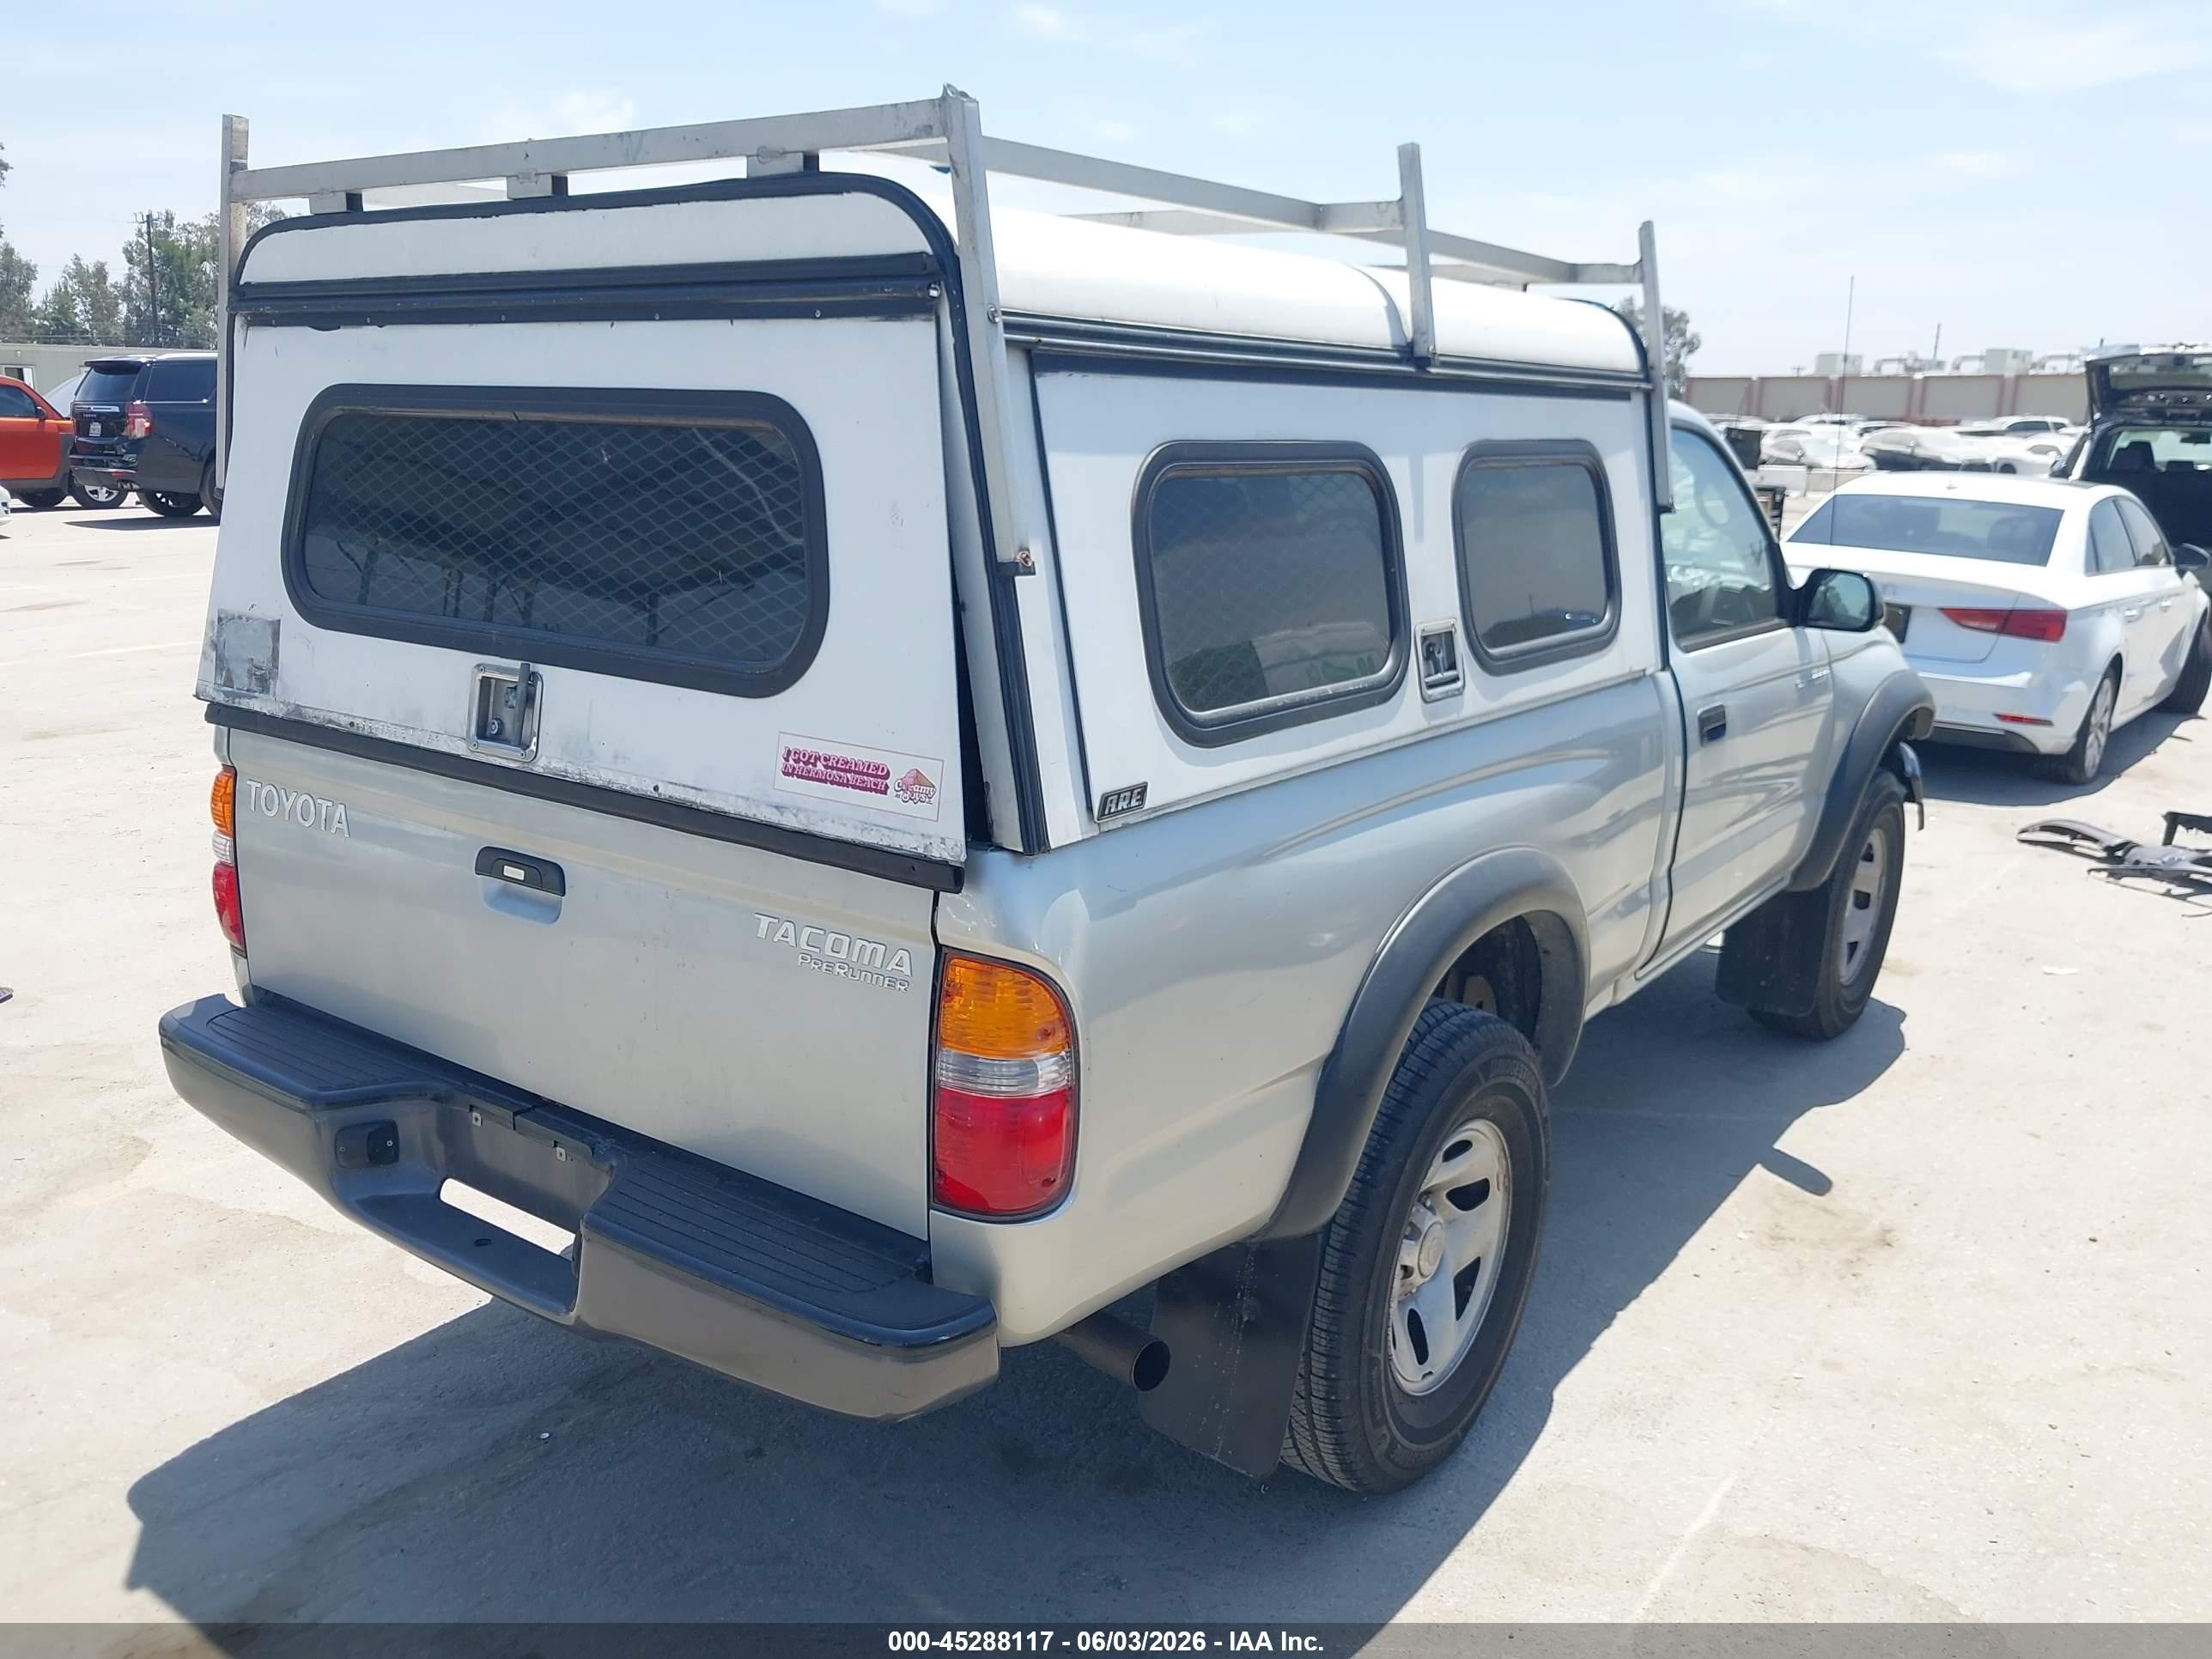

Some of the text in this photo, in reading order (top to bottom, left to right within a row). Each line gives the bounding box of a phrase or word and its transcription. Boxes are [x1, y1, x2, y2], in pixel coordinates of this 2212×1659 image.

[781, 763, 890, 794] IN HERMOSA BEACH
[790, 748, 818, 765] GOT
[819, 752, 890, 780] CREAMED
[894, 778, 936, 799] Creamy
[246, 779, 350, 838] TOYOTA
[754, 913, 913, 976] TACOMA
